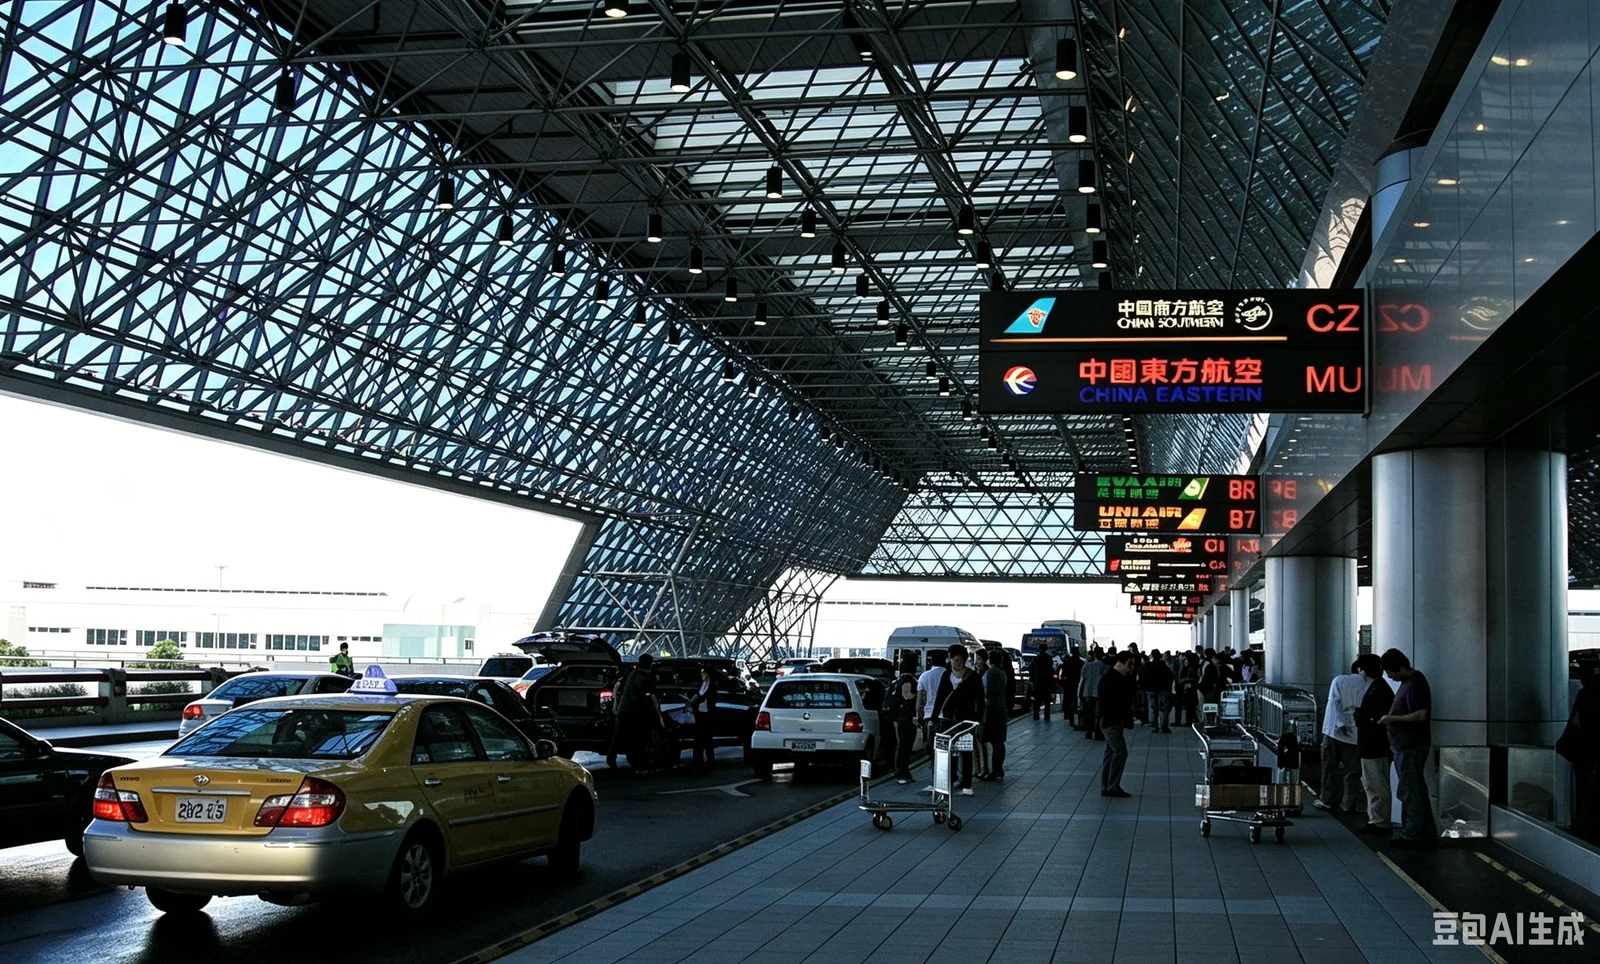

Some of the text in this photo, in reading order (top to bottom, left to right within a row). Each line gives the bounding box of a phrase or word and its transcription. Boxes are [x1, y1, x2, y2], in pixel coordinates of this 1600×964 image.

[1306, 303, 1360, 333] CZ
[1079, 357, 1263, 385] 中國東方航空
[1306, 365, 1362, 394] MU
[1079, 386, 1262, 404] CHINA EASTERN
[1229, 479, 1256, 500] BR
[1098, 506, 1182, 518] UNI AIR
[1229, 509, 1256, 530] B7
